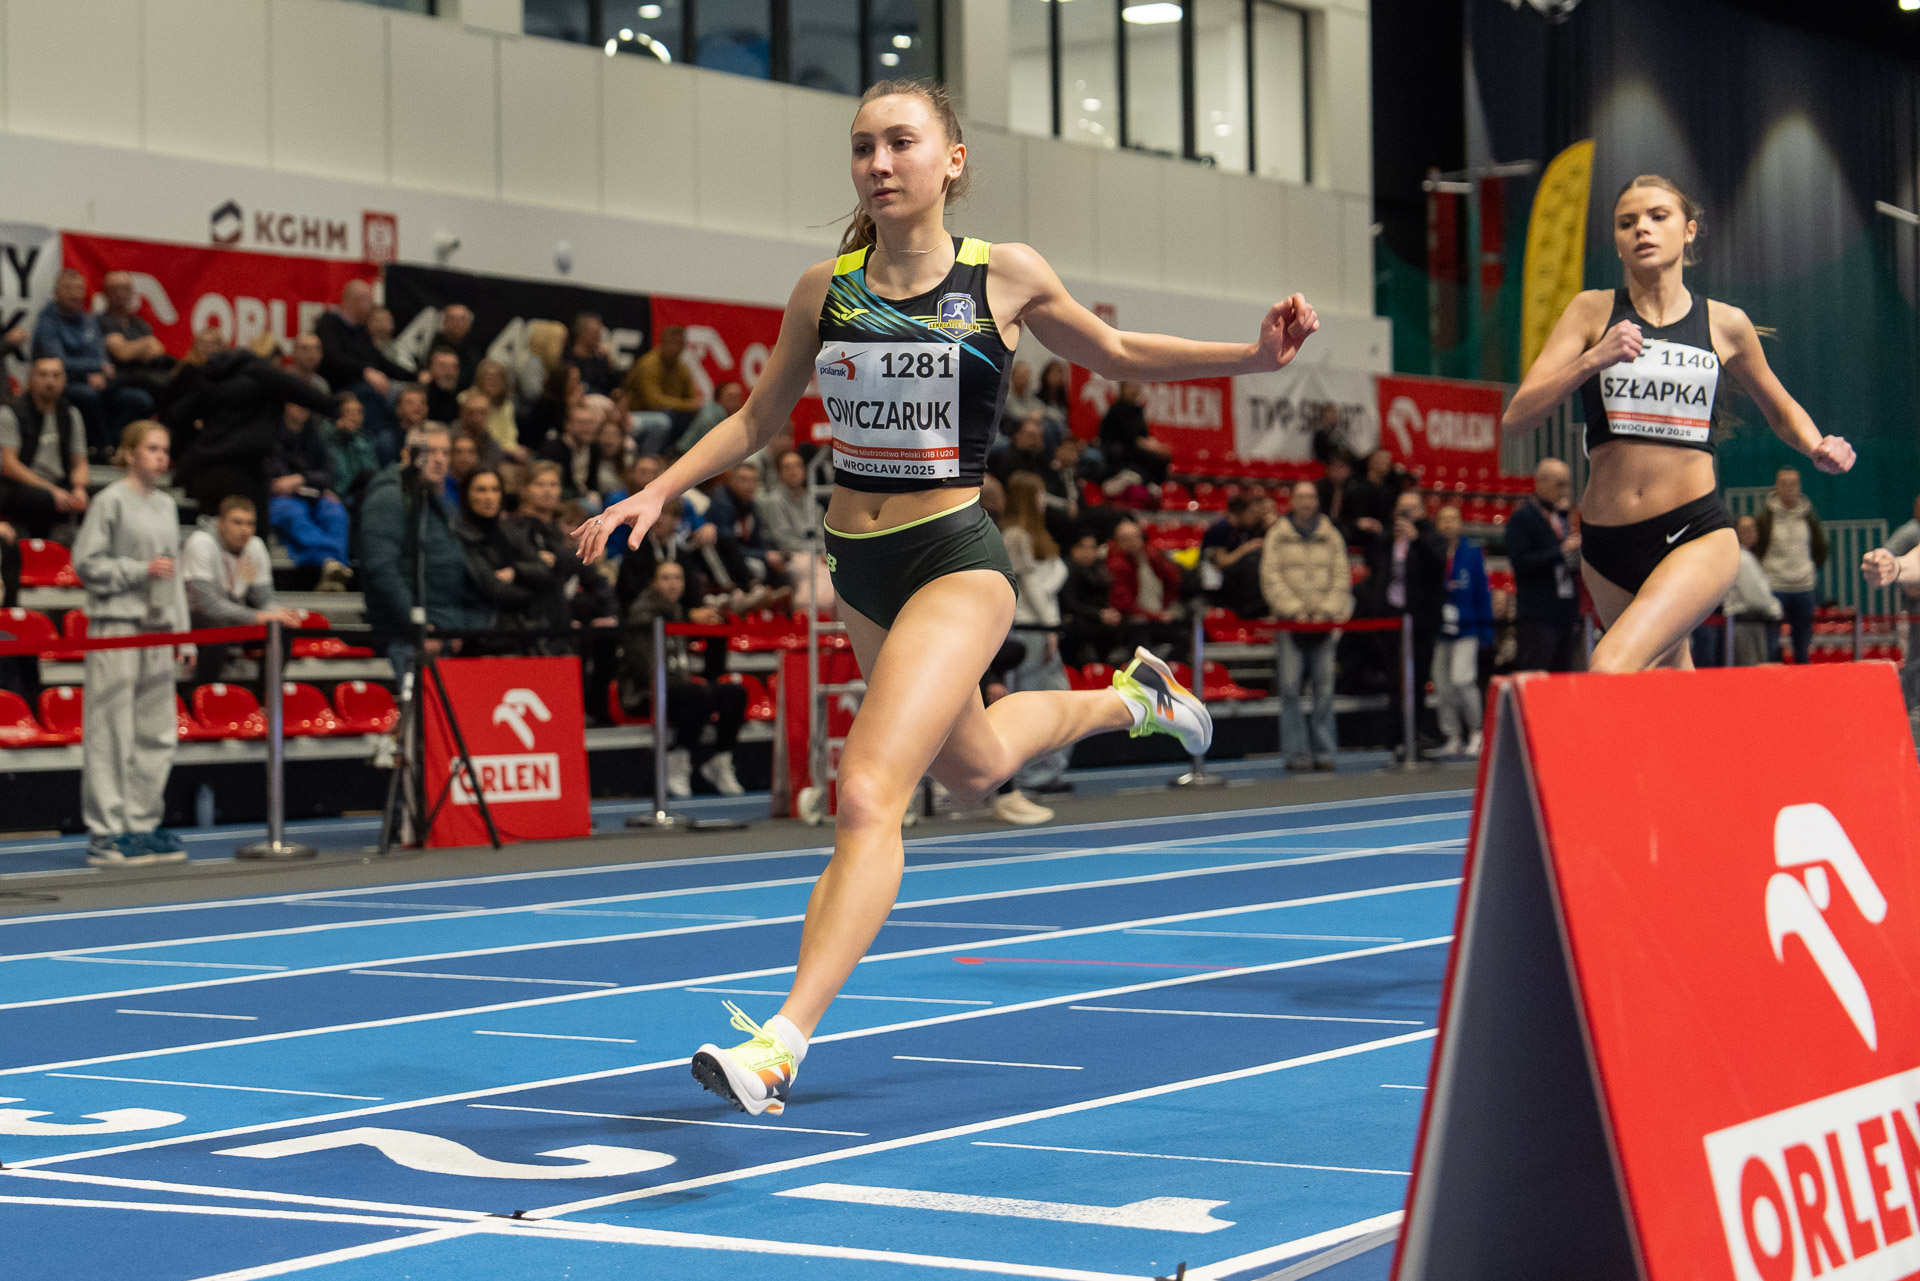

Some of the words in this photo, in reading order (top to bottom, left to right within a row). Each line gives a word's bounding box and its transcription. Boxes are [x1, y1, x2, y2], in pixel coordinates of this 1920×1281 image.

[254, 210, 347, 251] KGHM
[820, 366, 847, 377] polanik
[880, 352, 954, 378] 1281
[1661, 350, 1715, 369] 1140
[1604, 377, 1707, 406] SZŁAPKA
[827, 397, 952, 430] OWCZARUK
[1426, 408, 1496, 452] ORLEN
[1611, 422, 1665, 435] WROCŁAW
[1667, 427, 1691, 437] 2025
[843, 458, 901, 475] WROCŁAW
[904, 465, 935, 475] 2025
[859, 449, 899, 458] Mistrzostwa
[922, 451, 935, 459] U18
[940, 449, 954, 457] U20
[459, 761, 551, 794] ORLEN
[210, 1126, 677, 1180] 2
